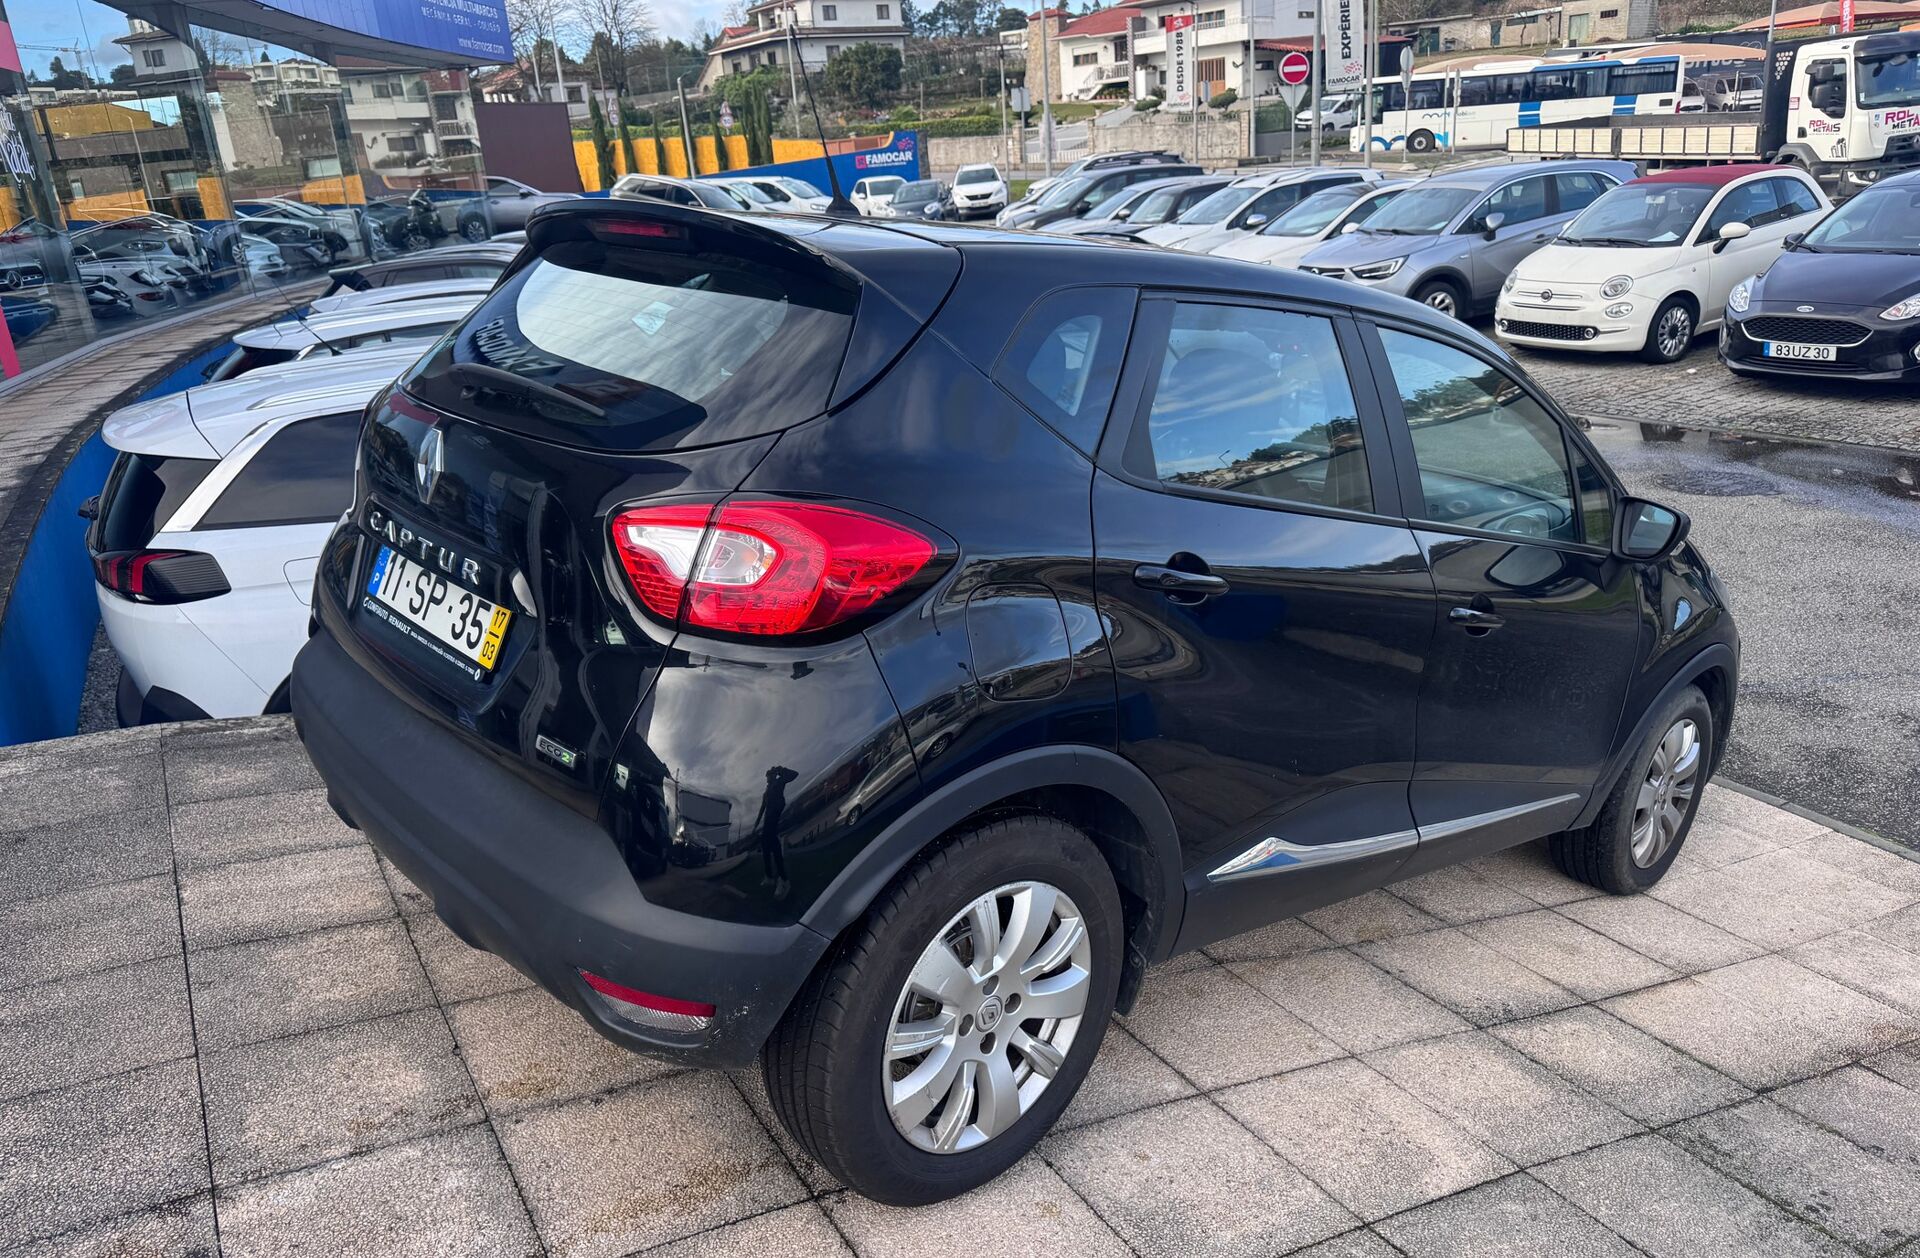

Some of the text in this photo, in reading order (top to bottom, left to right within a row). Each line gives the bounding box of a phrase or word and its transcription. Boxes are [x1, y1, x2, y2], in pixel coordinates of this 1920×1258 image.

[1175, 31, 1184, 92] DESDE 1988
[1327, 75, 1360, 85] FAMOCAR
[865, 151, 913, 165] FAMOCAR
[370, 511, 481, 586] CAPTUR
[388, 614, 411, 635] RENAULT
[493, 609, 507, 629] 17
[482, 640, 496, 661] 03
